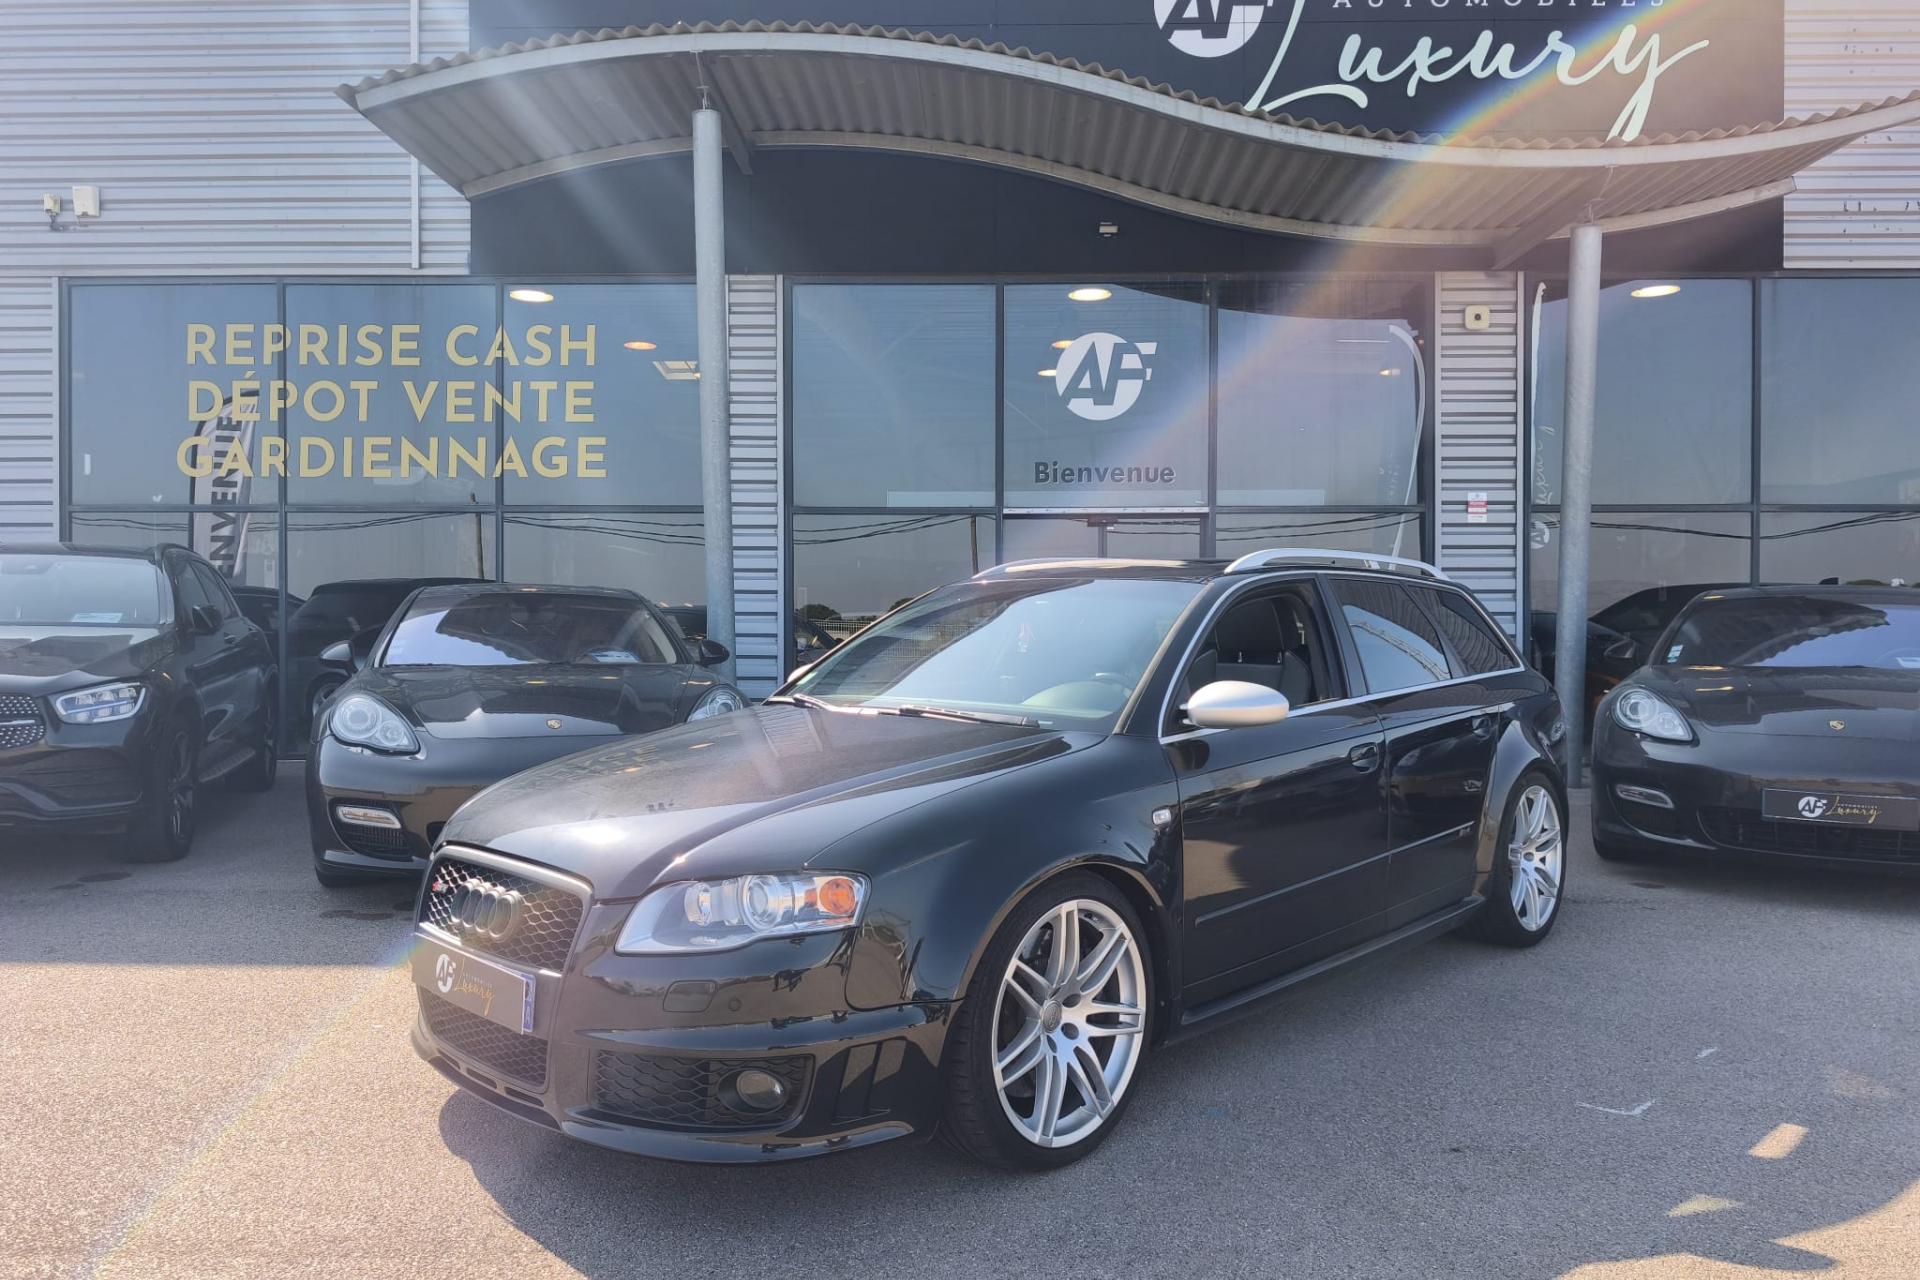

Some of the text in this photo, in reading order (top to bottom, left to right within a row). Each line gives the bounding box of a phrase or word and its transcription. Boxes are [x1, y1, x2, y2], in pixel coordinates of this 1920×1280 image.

[1243, 0, 1709, 142] Luxury
[186, 323, 597, 367] REPRISE CASH
[1058, 336, 1157, 411] AF
[187, 371, 596, 423] DÉPOT VENTE
[176, 436, 608, 479] GARDIENNAGE
[1034, 460, 1177, 484] Bienvenue
[1799, 797, 1827, 816] AF
